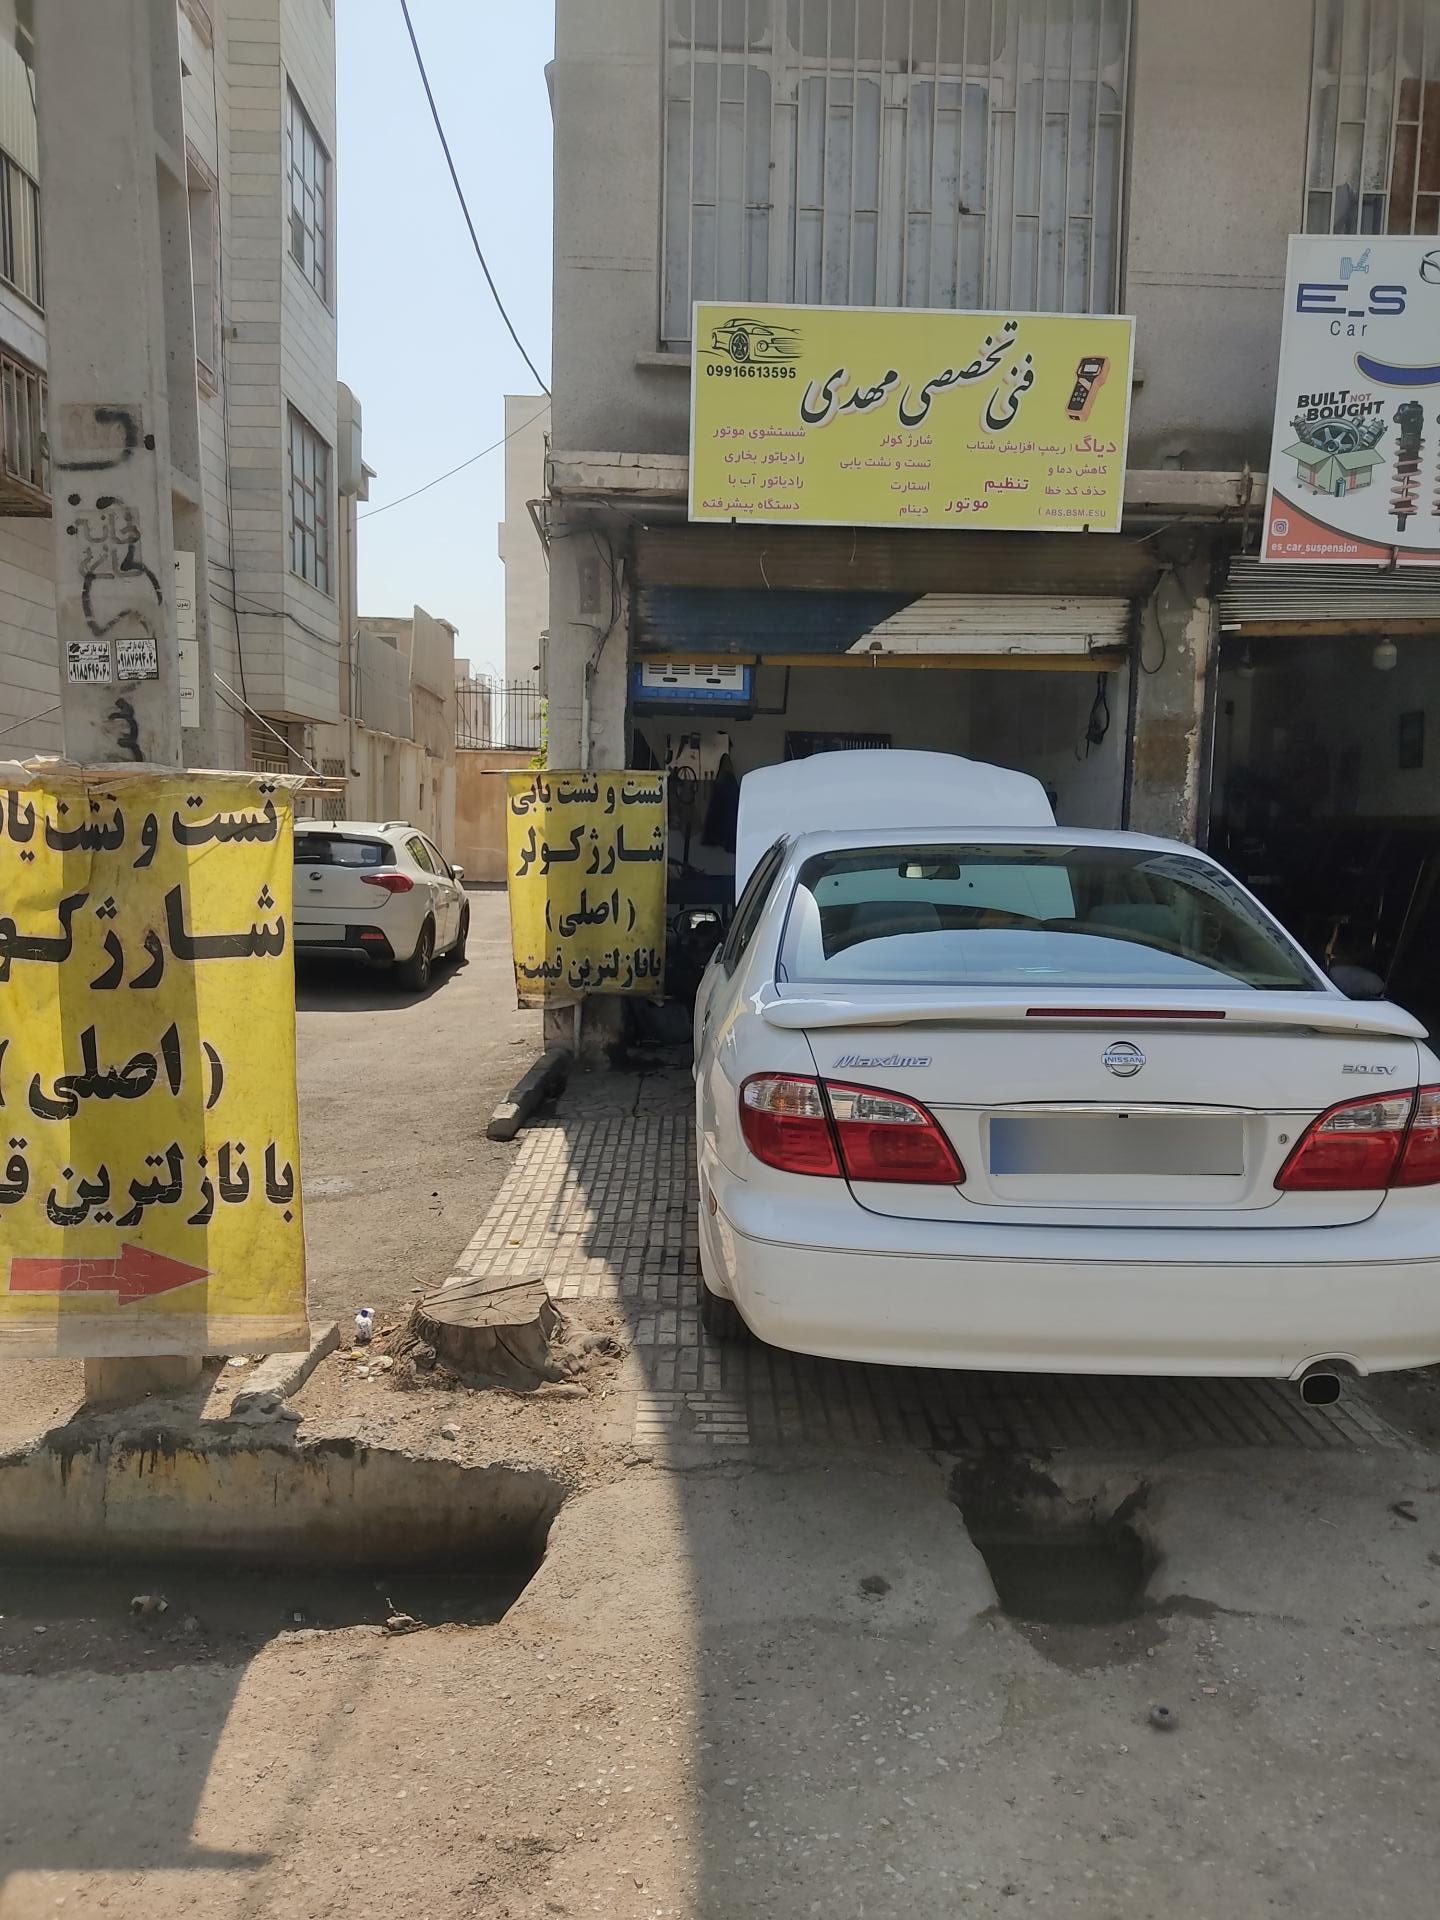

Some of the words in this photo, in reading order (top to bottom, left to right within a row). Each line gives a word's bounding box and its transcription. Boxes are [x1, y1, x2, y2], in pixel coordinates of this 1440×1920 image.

[1330, 320, 1368, 336] Car
[707, 364, 797, 380] 09916613595
[899, 319, 1018, 427] تخصصی
[801, 368, 898, 424] مهدی
[986, 354, 1036, 430] فنی
[1297, 390, 1350, 408] BUILT
[1350, 393, 1372, 403] NOT
[1306, 400, 1385, 421] BOUGHT
[713, 426, 745, 439] موتور
[749, 425, 805, 439] شستشوی
[880, 434, 903, 448] کولر
[906, 434, 934, 449] شارژ
[966, 440, 996, 453] شتاب
[998, 441, 1035, 455] افزایش
[1075, 434, 1117, 458] دیاگ
[724, 451, 757, 464] بخاری
[761, 451, 805, 466] رادیاتور
[840, 456, 862, 470] یابی
[864, 457, 891, 469] نشت
[905, 457, 932, 469] تست
[894, 460, 901, 471] و
[1047, 467, 1054, 477] و
[1057, 465, 1072, 475] دما
[1075, 465, 1107, 478] کاهش
[728, 474, 737, 488] با
[740, 473, 757, 487] آب
[760, 474, 804, 489] رادیاتور
[890, 480, 931, 493] استارت
[984, 476, 1029, 494] تنظیم
[1044, 485, 1061, 497] خطا
[1065, 486, 1078, 496] کد
[1081, 486, 1106, 497] حذف
[702, 497, 754, 514] پیشرفته
[757, 497, 800, 511] دستگاه
[899, 502, 929, 517] دینام
[945, 496, 989, 513] موتور
[1271, 542, 1357, 555] es_car_suspension
[511, 774, 553, 815] یابی
[557, 772, 599, 804] نشت
[621, 775, 664, 804] تست
[603, 786, 615, 815] و
[172, 784, 277, 845] تست
[133, 812, 159, 868] و
[515, 824, 585, 876] کولر
[585, 823, 664, 875] شارژ
[86, 884, 286, 990] شارژ
[523, 947, 563, 986] قیمت
[649, 948, 662, 985] با
[832, 1053, 933, 1069] Maxima
[1105, 1055, 1144, 1065] NISSAN
[265, 1142, 294, 1223] با
